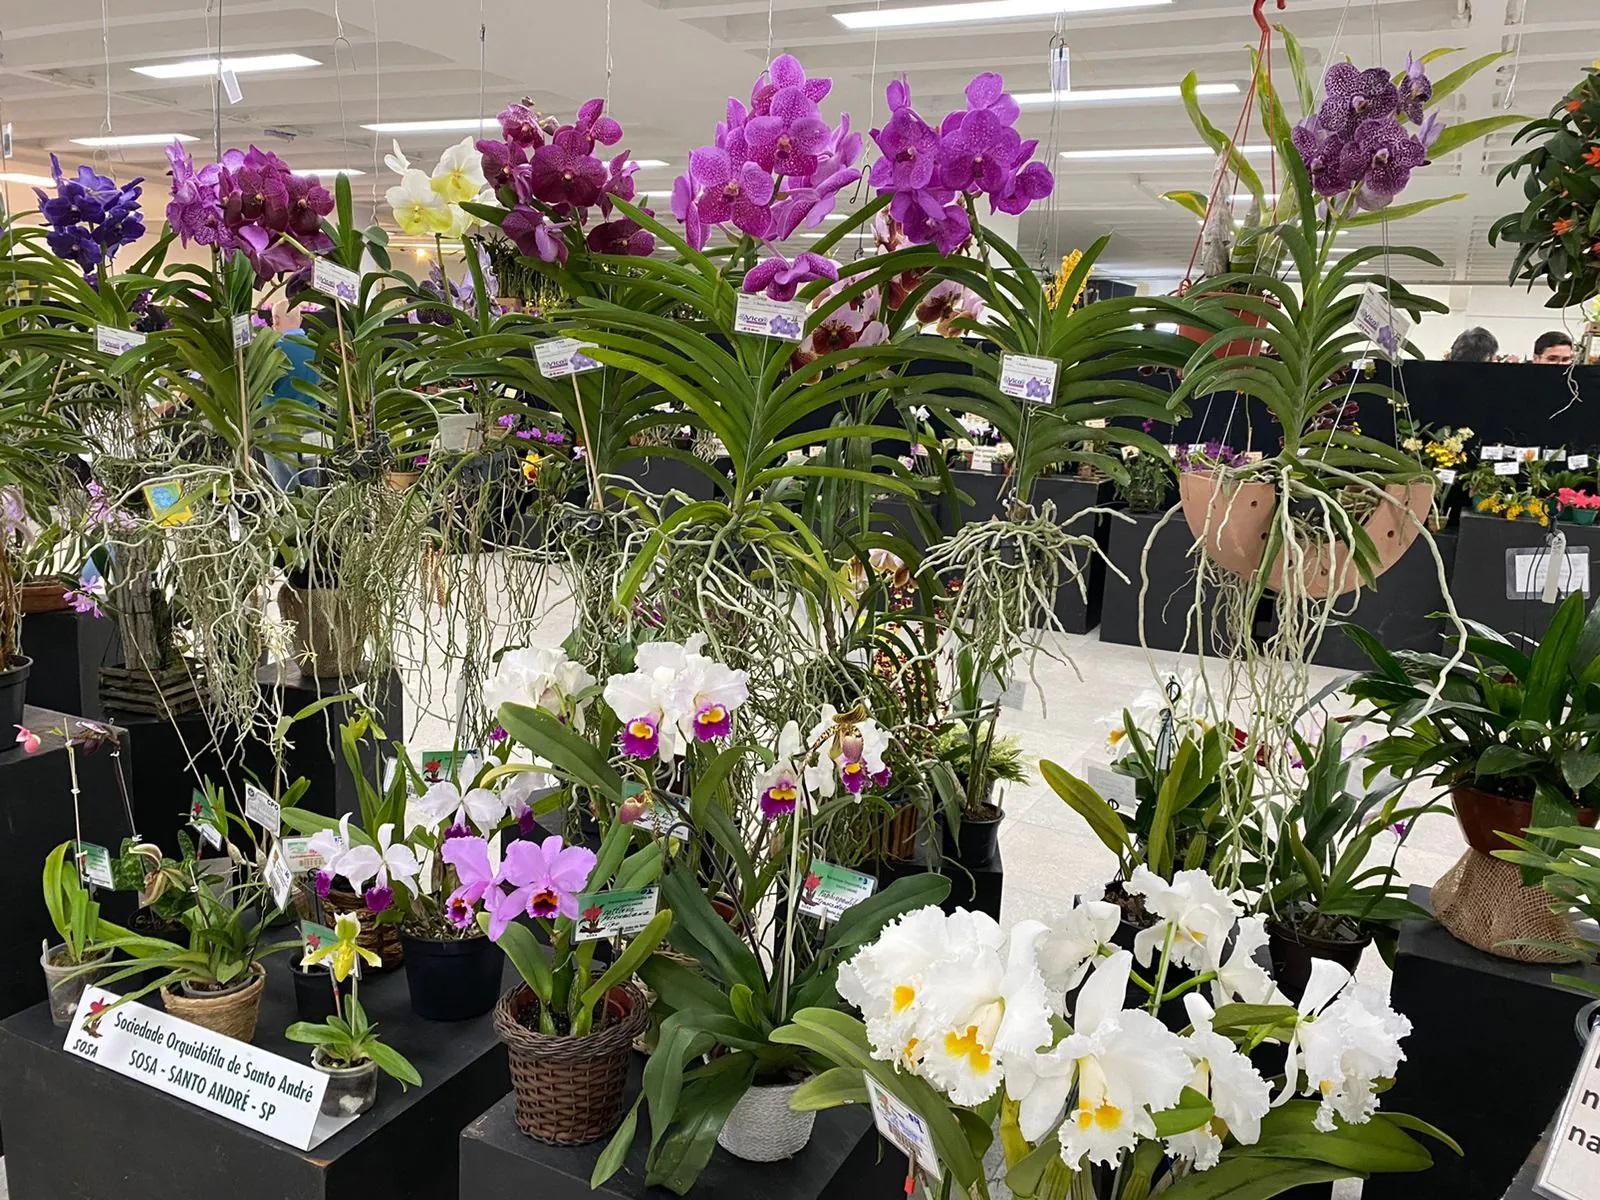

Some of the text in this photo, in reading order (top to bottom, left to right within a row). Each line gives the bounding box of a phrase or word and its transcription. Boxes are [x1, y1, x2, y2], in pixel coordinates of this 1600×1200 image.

[72, 1038, 99, 1058] SOSA
[114, 1011, 313, 1103] Sociedade Orquidófila de Santo André
[128, 1049, 158, 1075] SOSA
[167, 1065, 207, 1094] SANTO
[207, 1081, 251, 1112] ANDRÉ
[258, 1101, 276, 1121] SP
